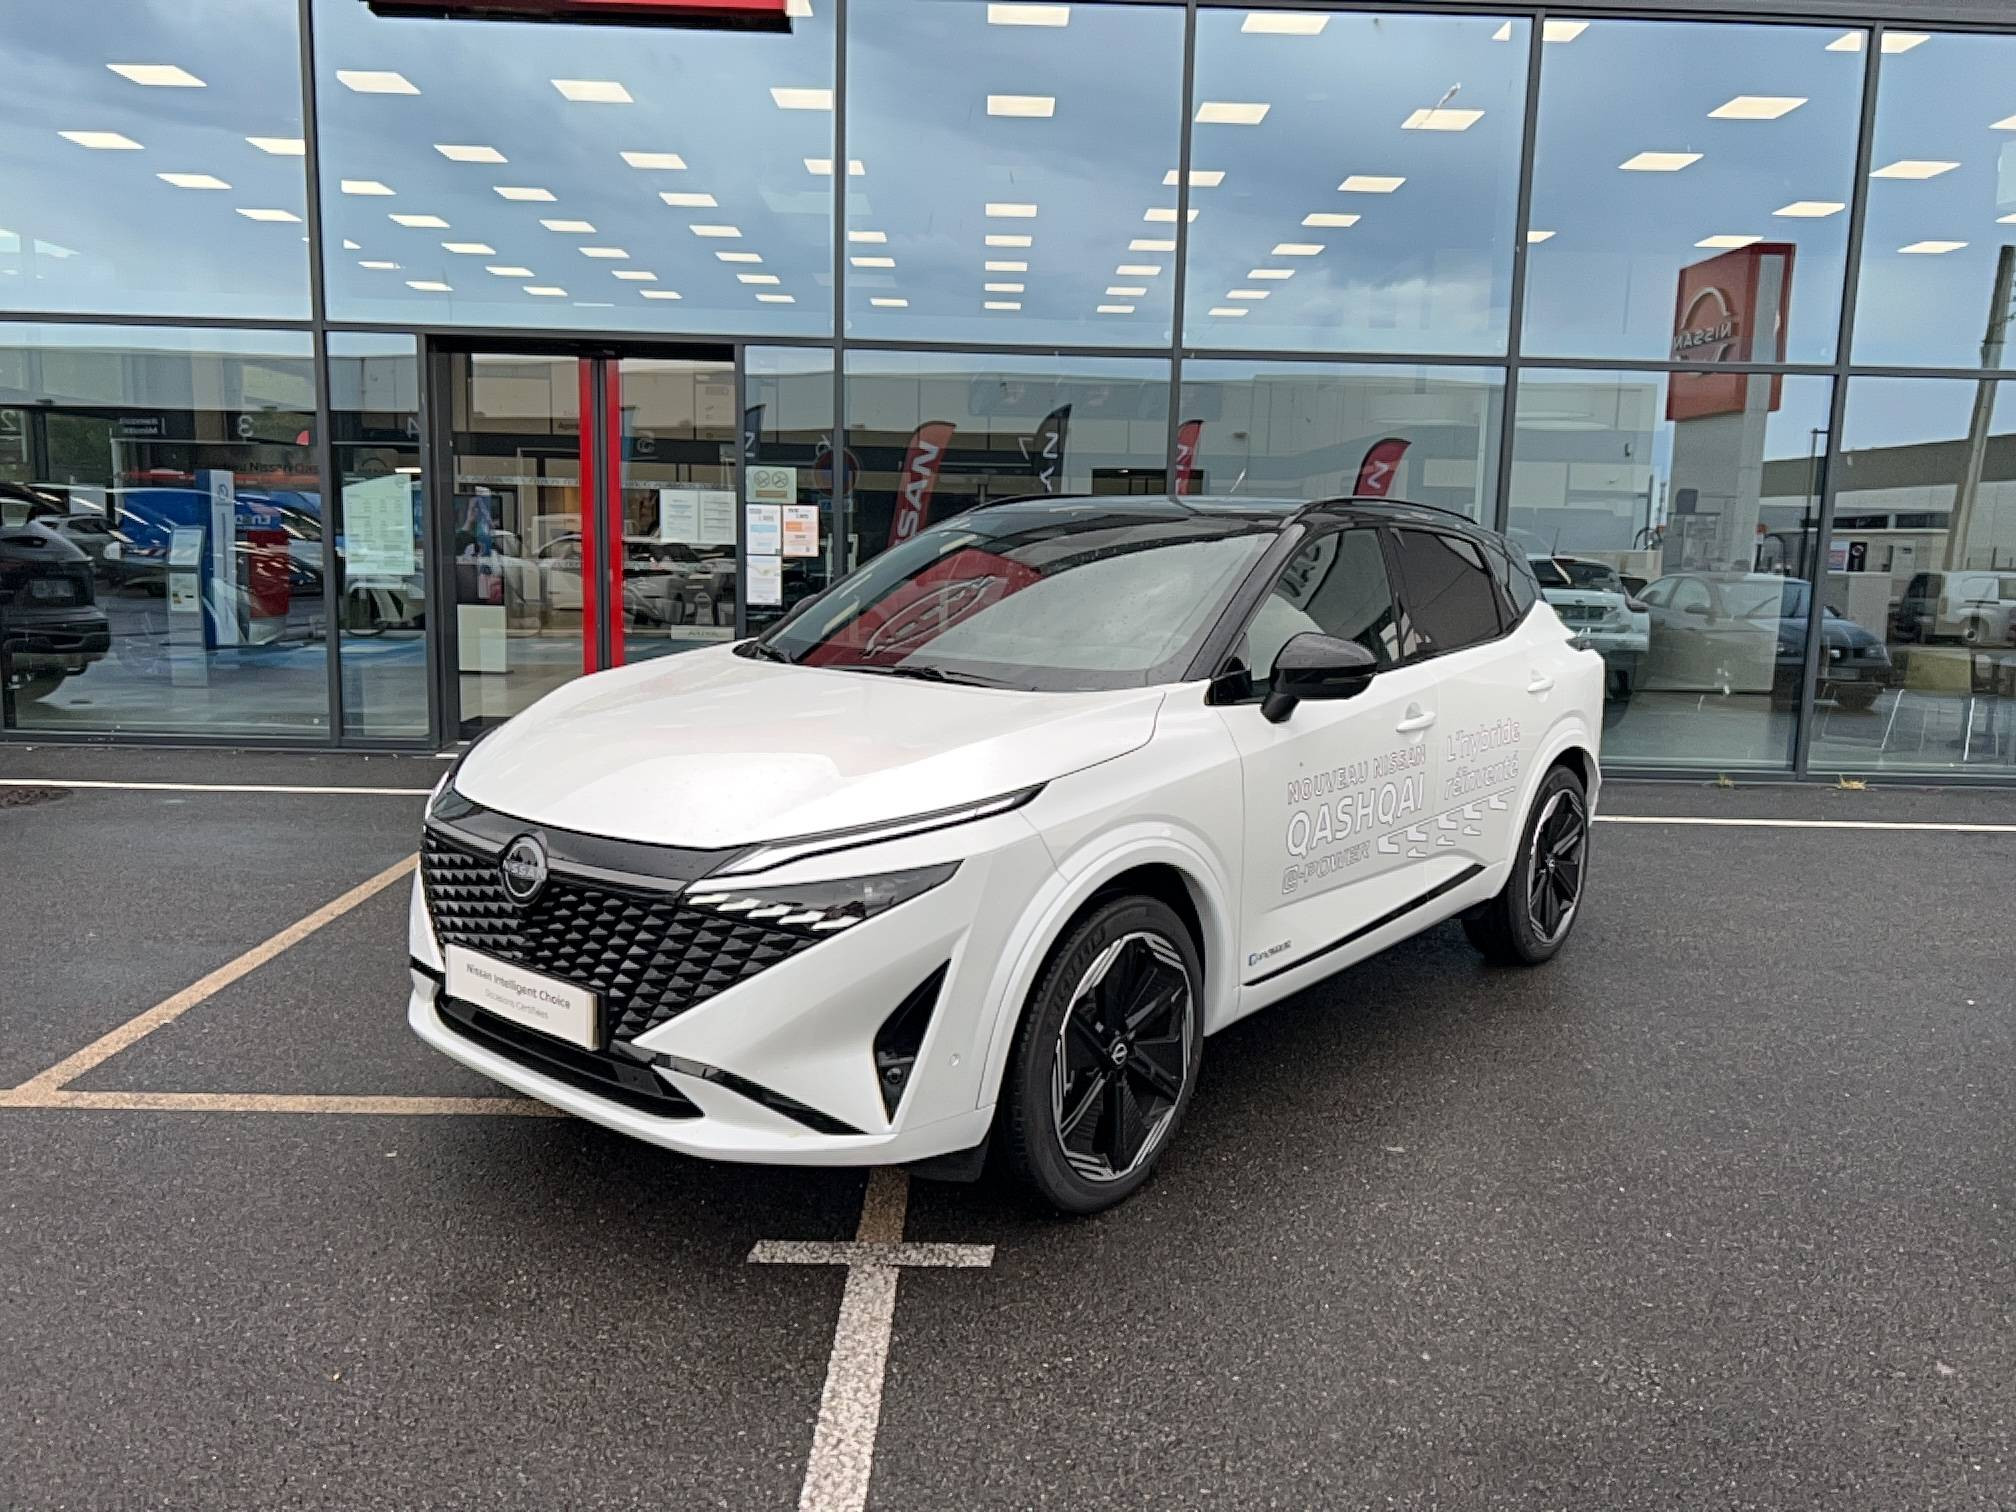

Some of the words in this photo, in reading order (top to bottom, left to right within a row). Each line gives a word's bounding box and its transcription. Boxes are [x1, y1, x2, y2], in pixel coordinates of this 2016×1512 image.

[1288, 761, 1369, 804] NOUVEAU
[1373, 744, 1426, 779] NISSAN
[1286, 771, 1425, 859] QASHQAI
[503, 860, 547, 881] NISSAN
[466, 963, 493, 981] Nissan
[494, 974, 538, 1000] Intelligent
[539, 989, 571, 1009] Choice
